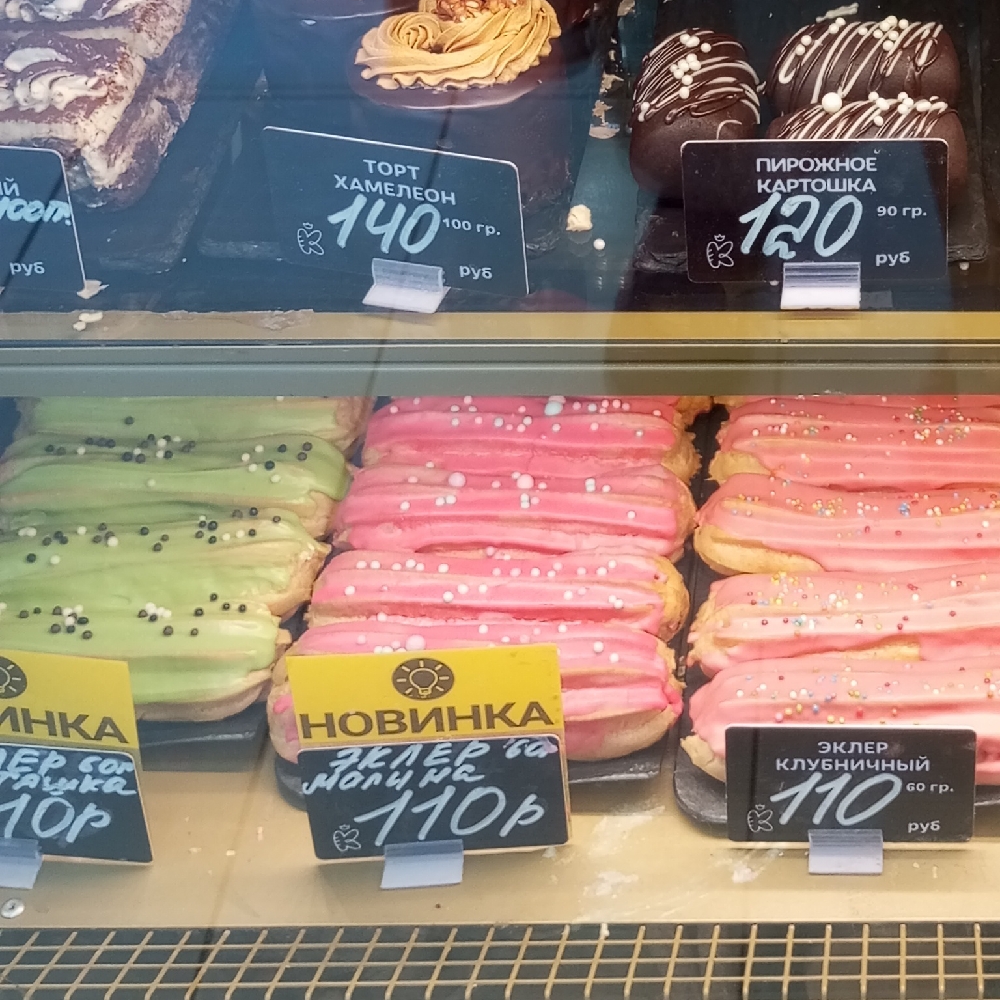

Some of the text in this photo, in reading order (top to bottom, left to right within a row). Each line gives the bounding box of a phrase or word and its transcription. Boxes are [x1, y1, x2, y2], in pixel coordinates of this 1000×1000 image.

[362, 159, 421, 181] ТОРТ
[756, 157, 878, 172] ПИРОЖНОЕ
[334, 174, 457, 206] ХАМЕЛЕОН
[757, 177, 877, 193] КАРТОШКА
[877, 205, 928, 219] 90 гр.
[327, 193, 441, 254] 140
[442, 218, 502, 237] 100 гр.
[738, 192, 864, 260] 120
[875, 251, 911, 267] руб
[9, 261, 46, 276] руб
[459, 265, 493, 280] руб
[299, 701, 555, 739] НОВИНКА
[818, 741, 889, 754] ЭКЛЕР
[775, 756, 931, 772] КЛУБНИЧНЫЙ
[906, 782, 954, 794] 60 гр.
[770, 772, 903, 826] 110
[907, 820, 941, 834] руб
